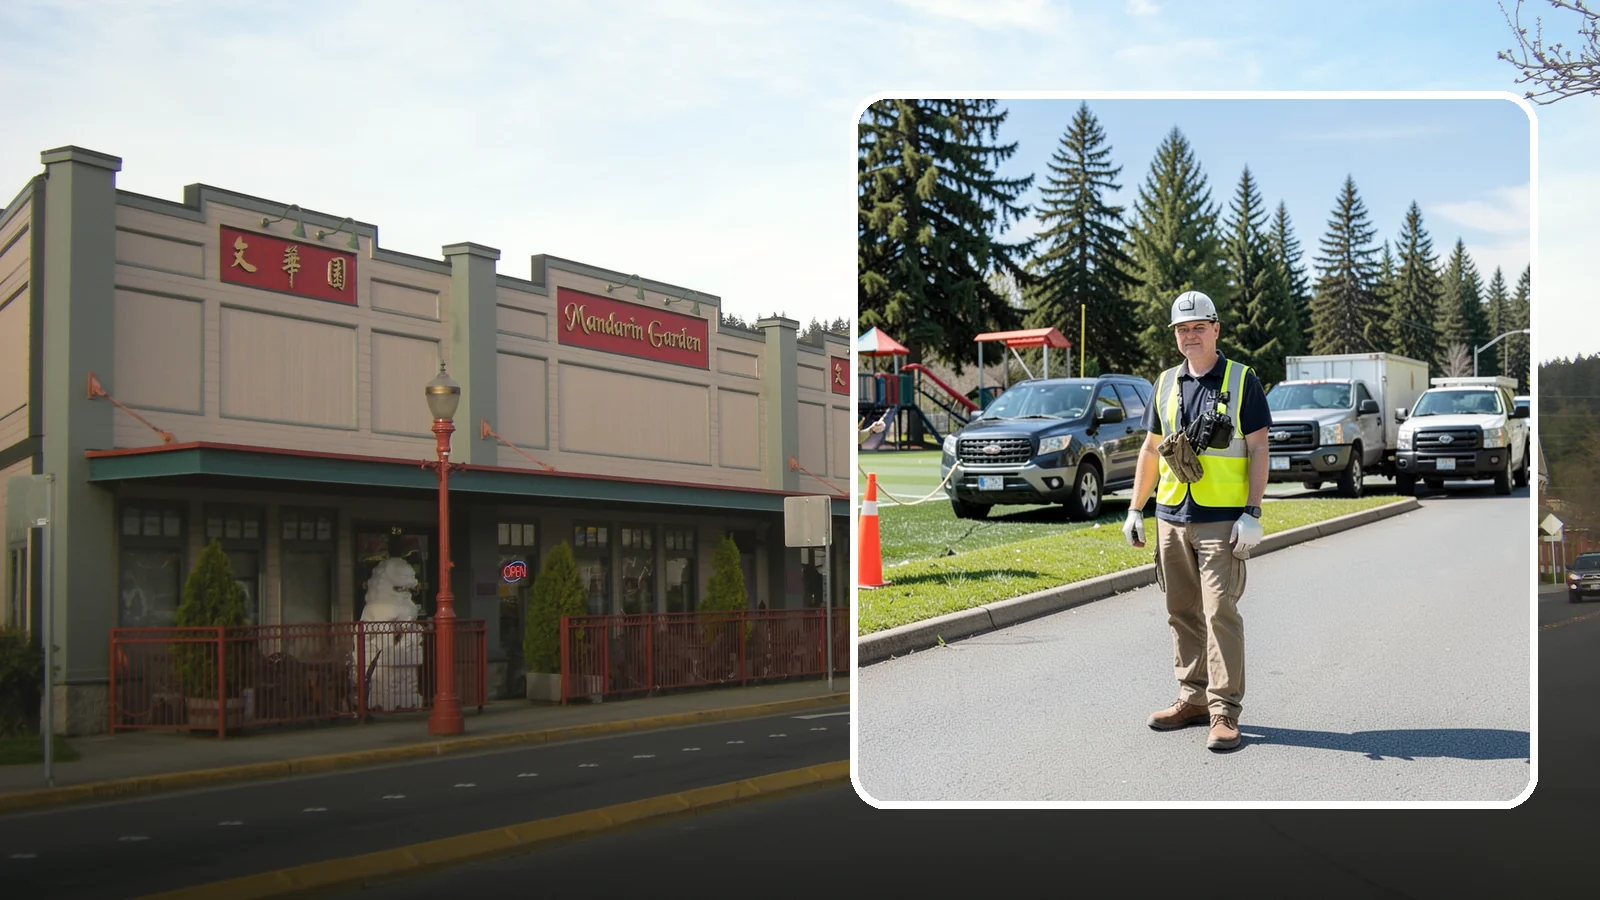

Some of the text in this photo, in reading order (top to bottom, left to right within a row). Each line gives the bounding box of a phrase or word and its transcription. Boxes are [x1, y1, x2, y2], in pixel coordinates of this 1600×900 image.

[231, 235, 346, 291] 文華園
[564, 302, 701, 352] Mandarin Garden
[834, 362, 846, 386] 文
[503, 565, 527, 578] OPEN
